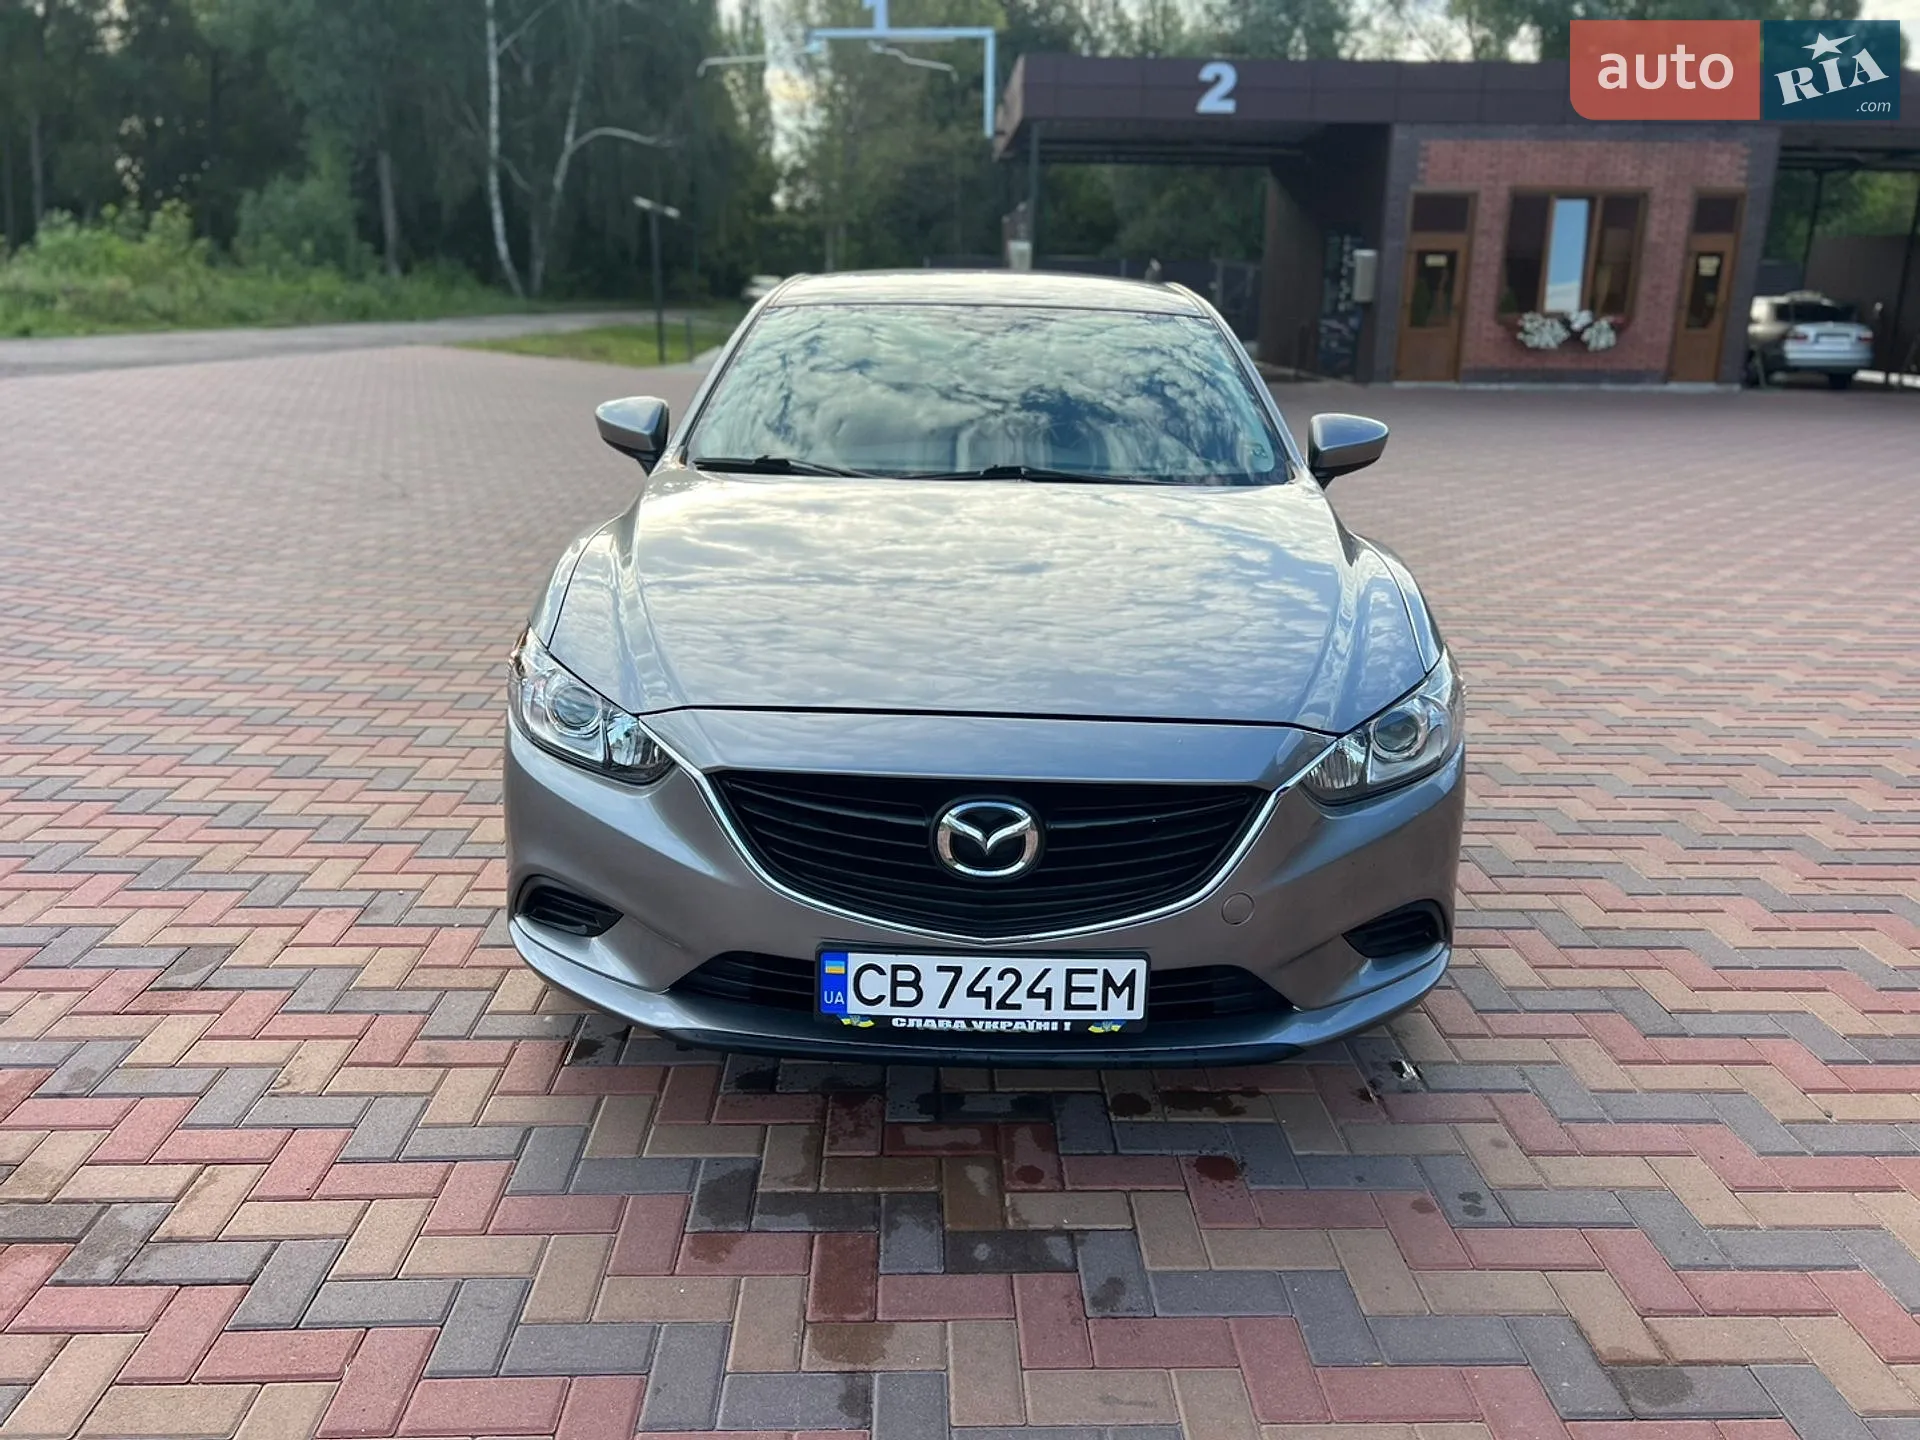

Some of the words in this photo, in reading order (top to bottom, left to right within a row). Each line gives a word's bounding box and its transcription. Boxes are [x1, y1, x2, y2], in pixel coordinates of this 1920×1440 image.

[1196, 61, 1237, 114] 2
[824, 990, 845, 1005] UA
[891, 1017, 967, 1031] СЛАВА
